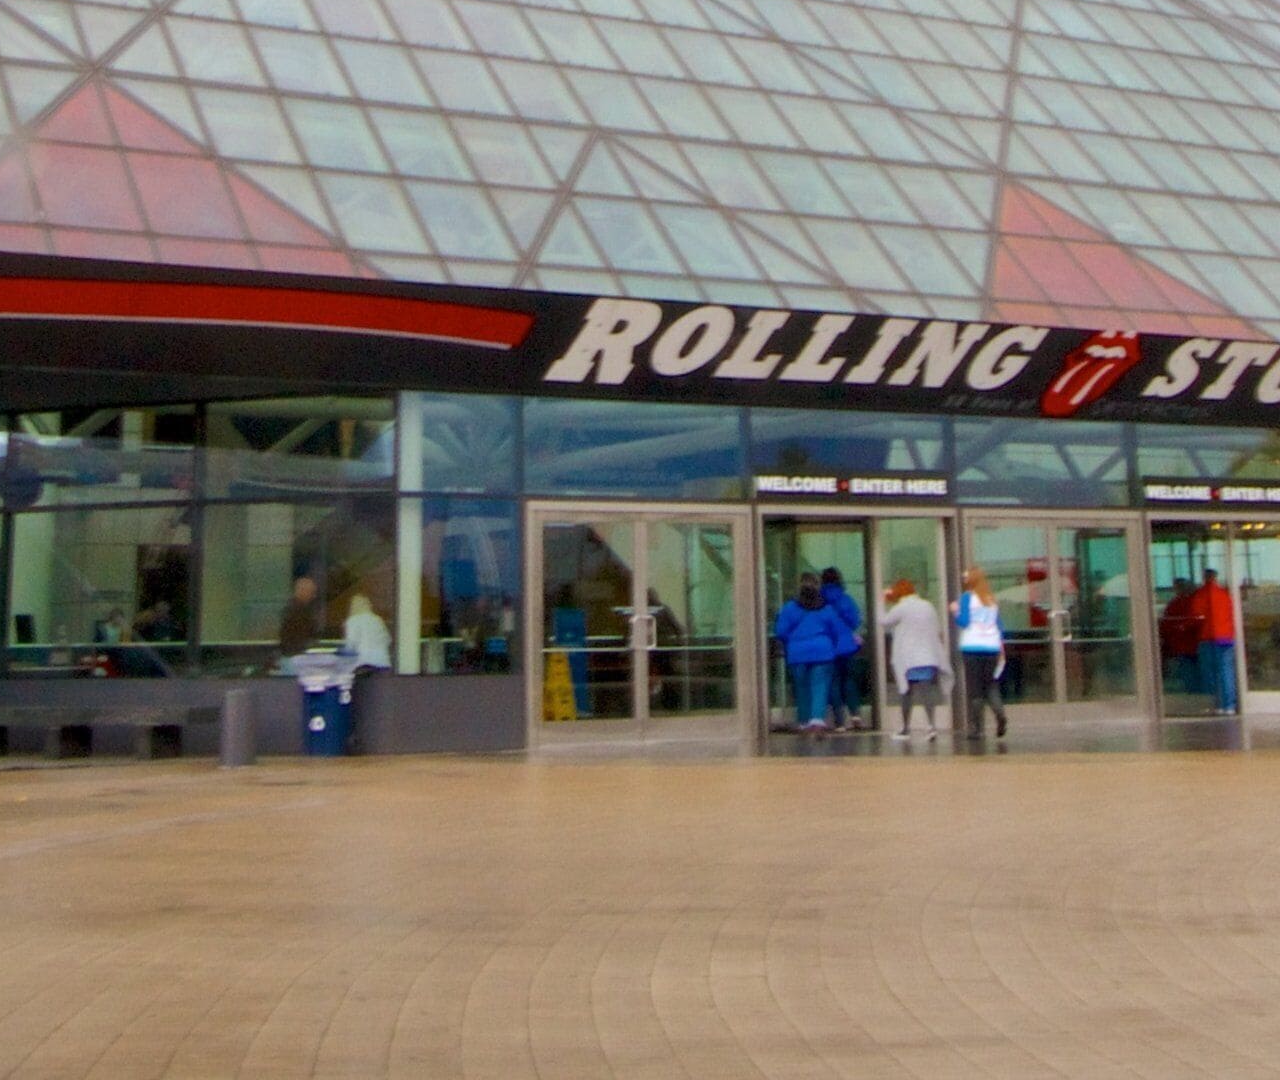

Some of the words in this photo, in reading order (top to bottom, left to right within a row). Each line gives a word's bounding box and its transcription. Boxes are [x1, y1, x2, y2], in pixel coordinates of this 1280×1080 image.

[543, 298, 1049, 391] ROLLING
[755, 476, 837, 493] WELCOME
[850, 477, 903, 494] ENTER
[907, 479, 947, 495] HERE
[1146, 485, 1211, 500] WELCOME
[1222, 486, 1265, 502] ENTER
